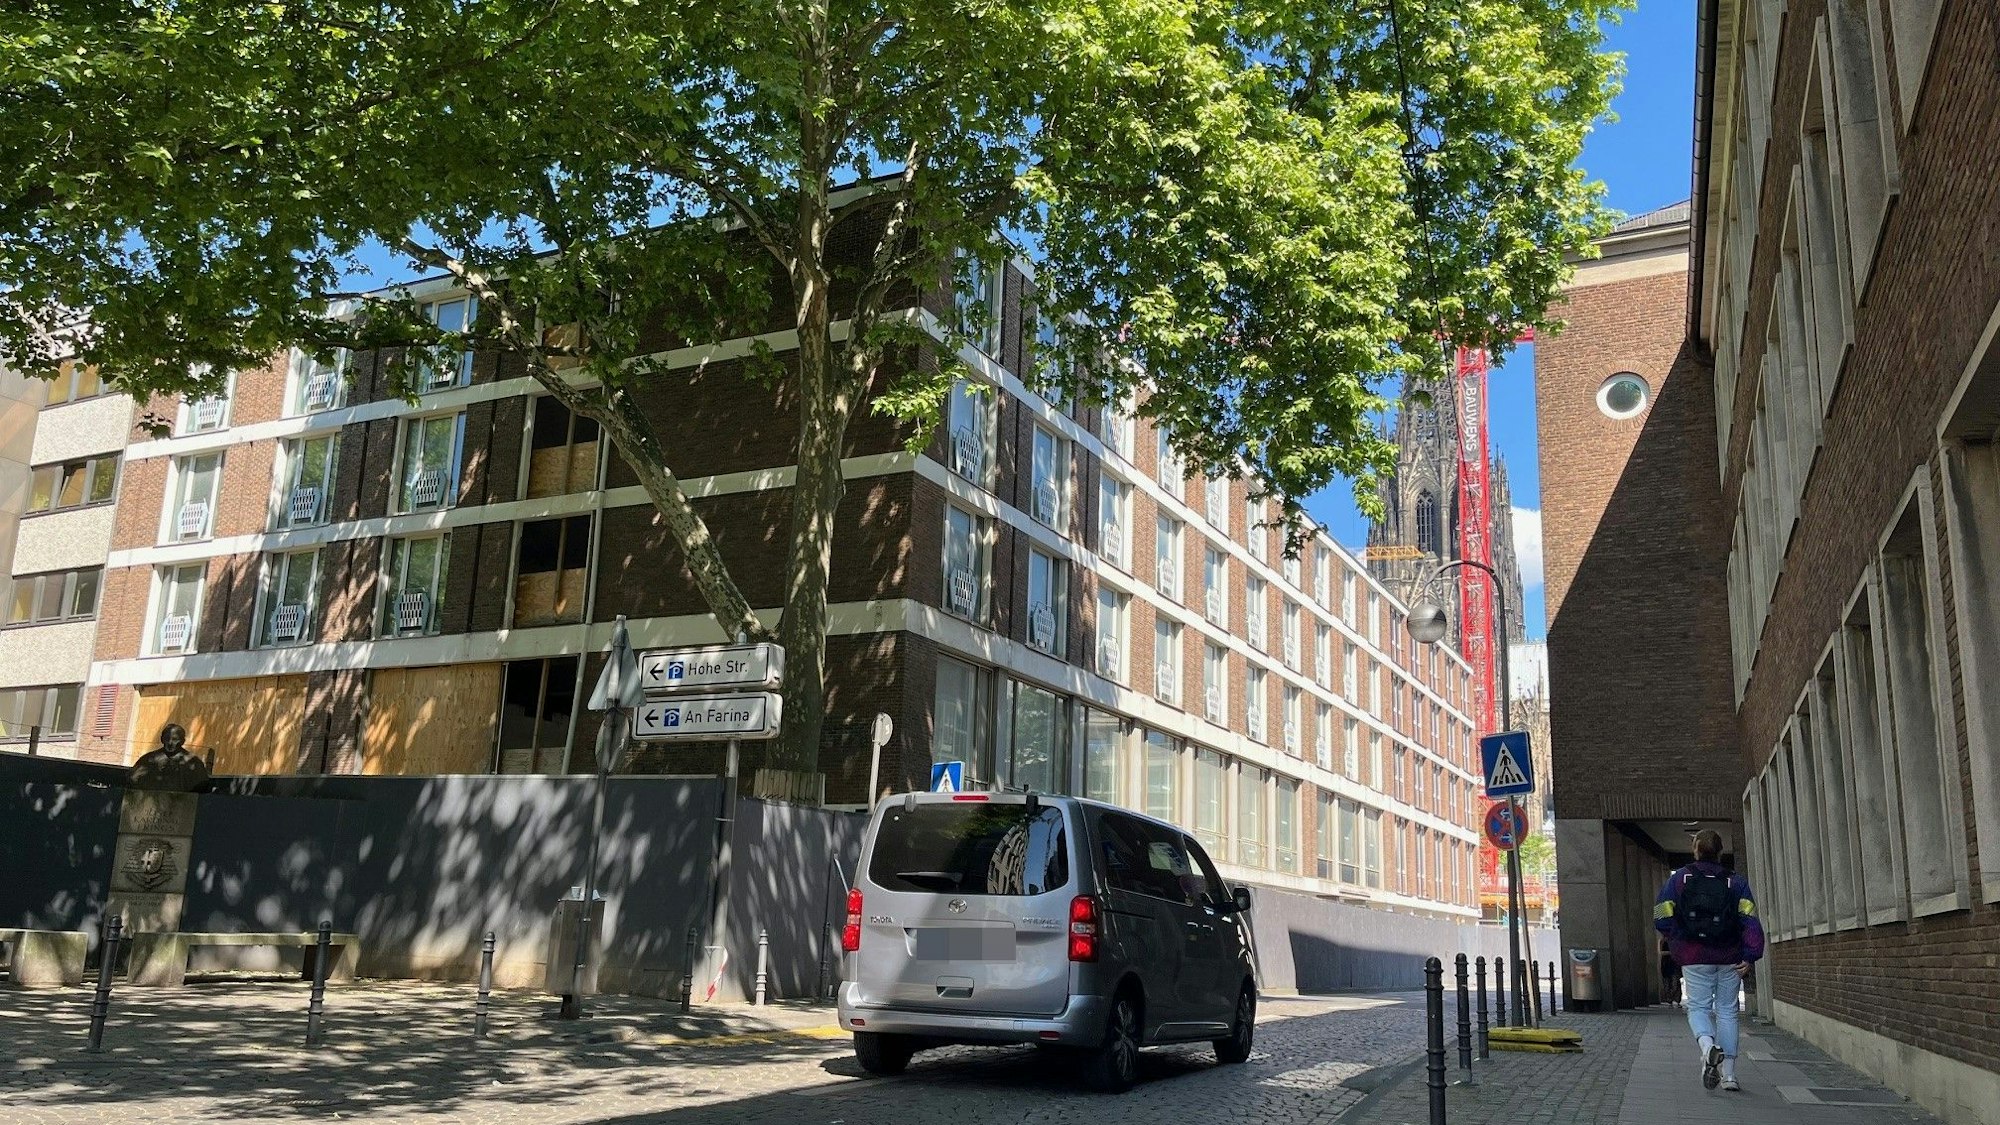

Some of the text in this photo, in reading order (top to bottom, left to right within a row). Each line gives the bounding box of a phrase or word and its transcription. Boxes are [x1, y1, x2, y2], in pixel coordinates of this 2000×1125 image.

[1466, 387, 1477, 452] BAUWENS
[688, 662, 721, 676] Hohe
[726, 660, 748, 673] Str.
[685, 710, 702, 723] An
[707, 708, 749, 723] Farina
[870, 916, 893, 924] TOYOTA
